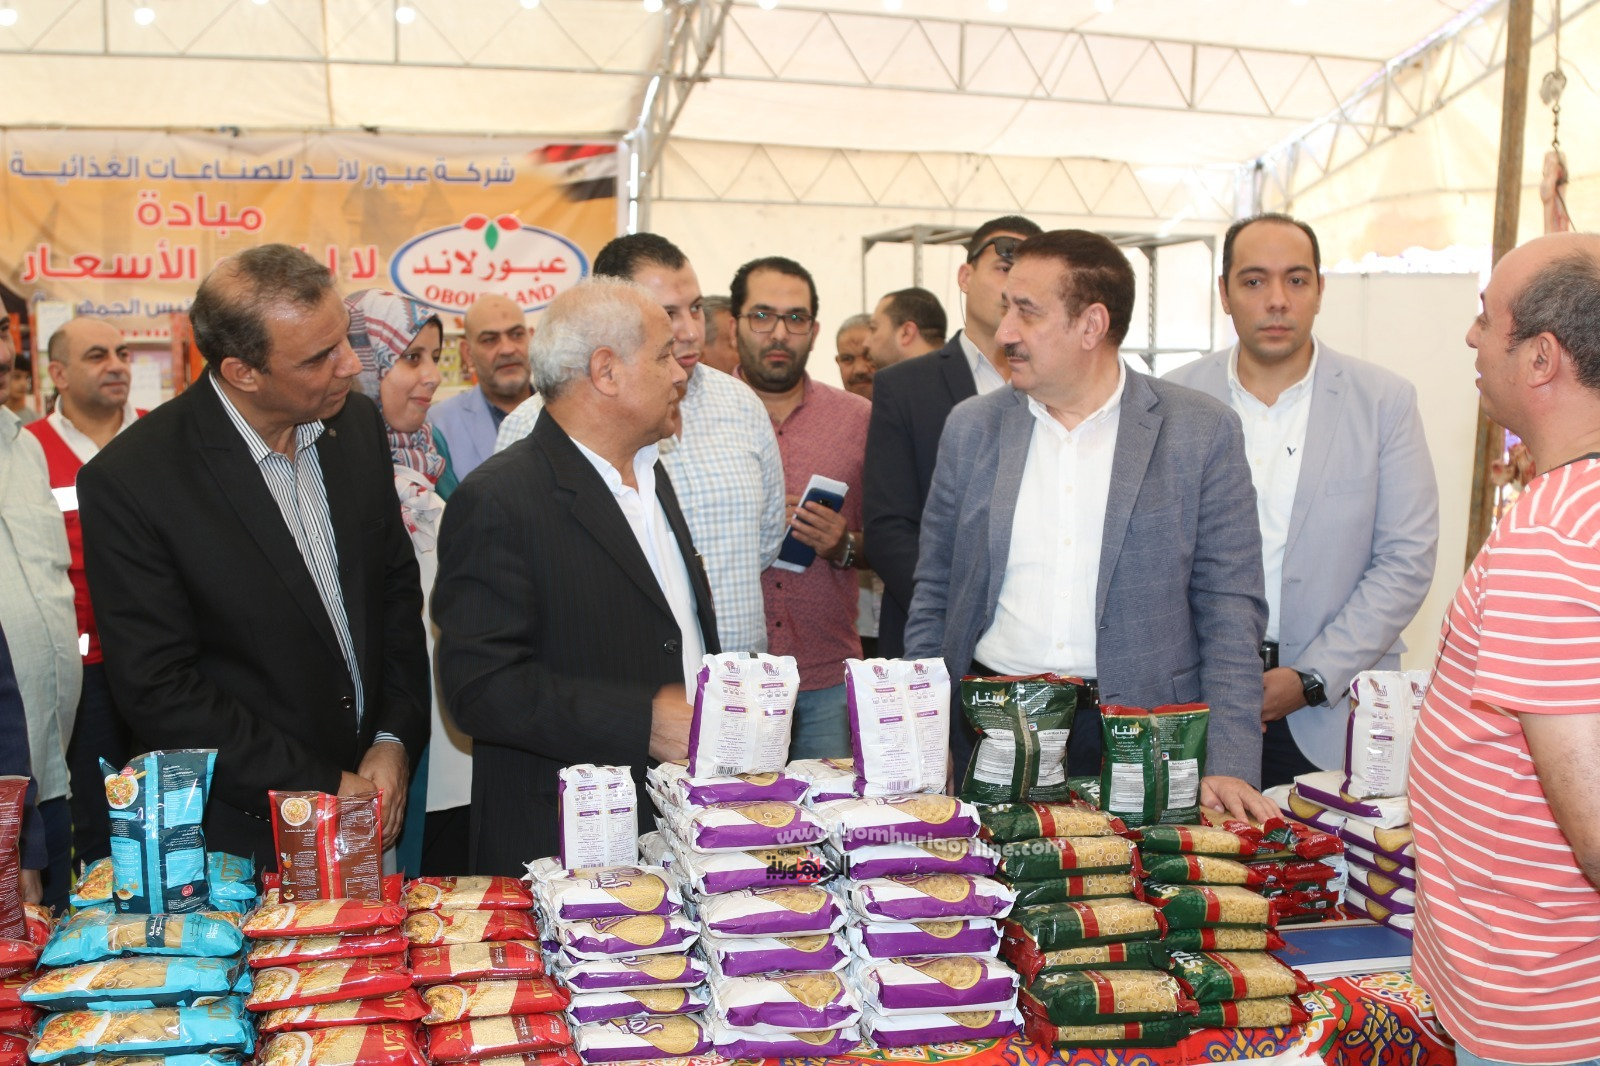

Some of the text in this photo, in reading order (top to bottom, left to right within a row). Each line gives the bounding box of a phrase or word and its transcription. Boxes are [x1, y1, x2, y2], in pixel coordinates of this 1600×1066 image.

[10, 152, 139, 185] الغذائية
[145, 156, 293, 181] للصناعات
[434, 157, 516, 187] شركة
[137, 191, 263, 235] مبادة
[22, 240, 196, 281] الأسعار
[1111, 724, 1139, 737] ستار
